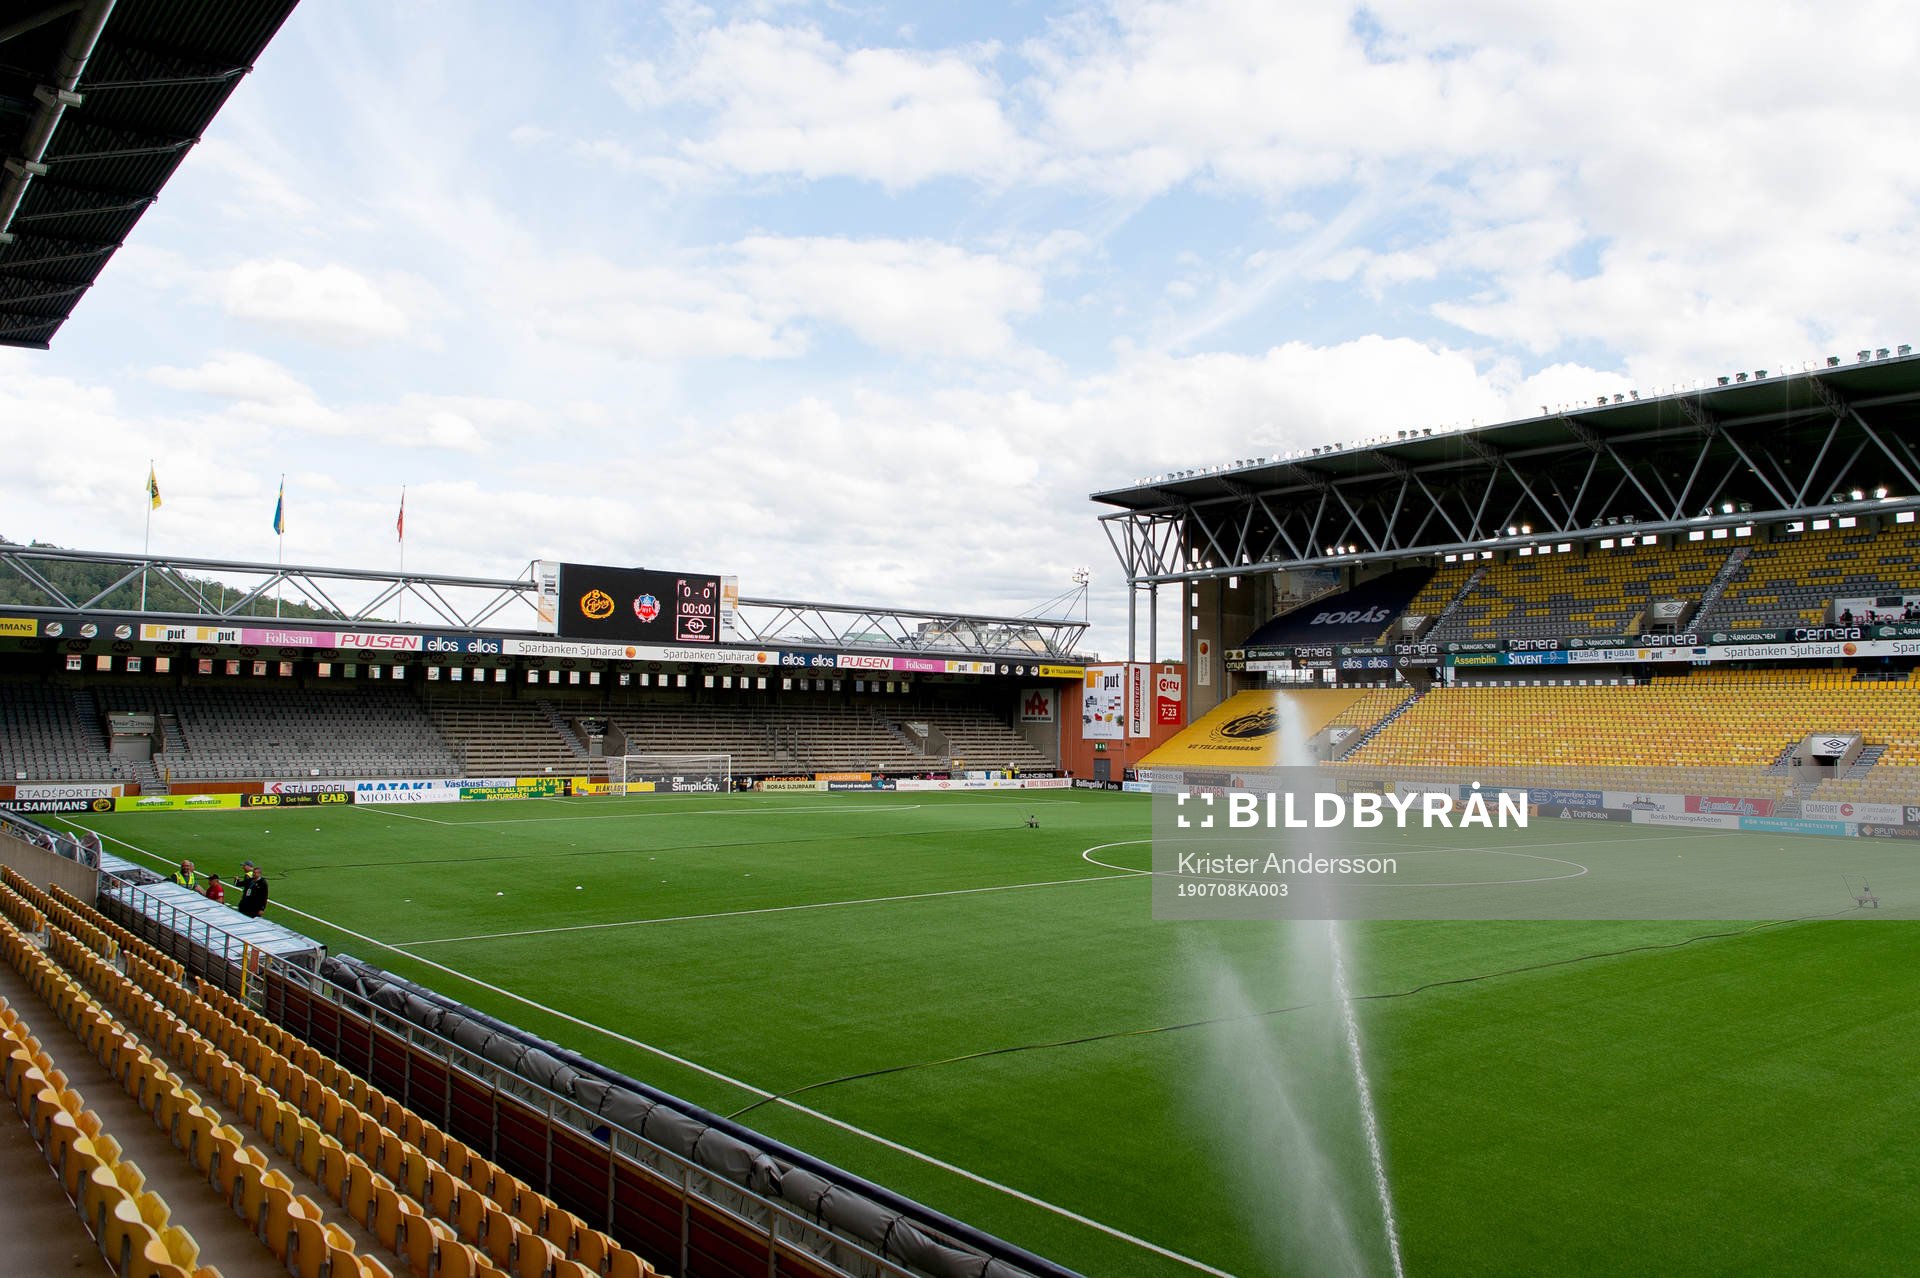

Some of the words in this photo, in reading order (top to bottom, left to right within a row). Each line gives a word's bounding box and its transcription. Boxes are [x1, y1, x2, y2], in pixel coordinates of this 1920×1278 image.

[684, 587, 691, 597] 0
[703, 588, 710, 598] 0
[682, 603, 711, 615] 00:00
[1310, 606, 1390, 624] BORÅS
[265, 631, 314, 645] Folksam
[1795, 627, 1861, 641] Cernera
[340, 634, 418, 650] PULSEN
[428, 637, 459, 652] ellos
[468, 638, 498, 653] ellos
[1509, 639, 1558, 650] Cernera
[1641, 634, 1698, 646] Cernera
[519, 642, 578, 658] Sparbanken
[1295, 648, 1332, 657] Cernera
[1395, 644, 1437, 655] Cernera
[1723, 646, 1787, 660] Sparbanken
[1790, 644, 1840, 658] Sjuhärad
[663, 648, 716, 664] Sparbanken
[782, 653, 806, 666] ellos
[811, 654, 834, 667] ellos
[1454, 656, 1496, 665] Assemblin
[1508, 653, 1543, 665] SILVENT
[840, 656, 890, 668] PULSEN
[905, 660, 933, 670] Folksam
[1226, 661, 1245, 669] onyx
[1343, 658, 1362, 668] ellos
[1368, 657, 1388, 668] ellos
[357, 782, 433, 792] MATAKI
[517, 785, 538, 793] SPELAS
[672, 781, 720, 793] Simplicity.
[18, 788, 108, 798] STADSPORTEN
[319, 793, 346, 803] EAB
[251, 796, 279, 805] EAB
[1806, 803, 1838, 813] COMFORT
[1651, 812, 1668, 820] Borås
